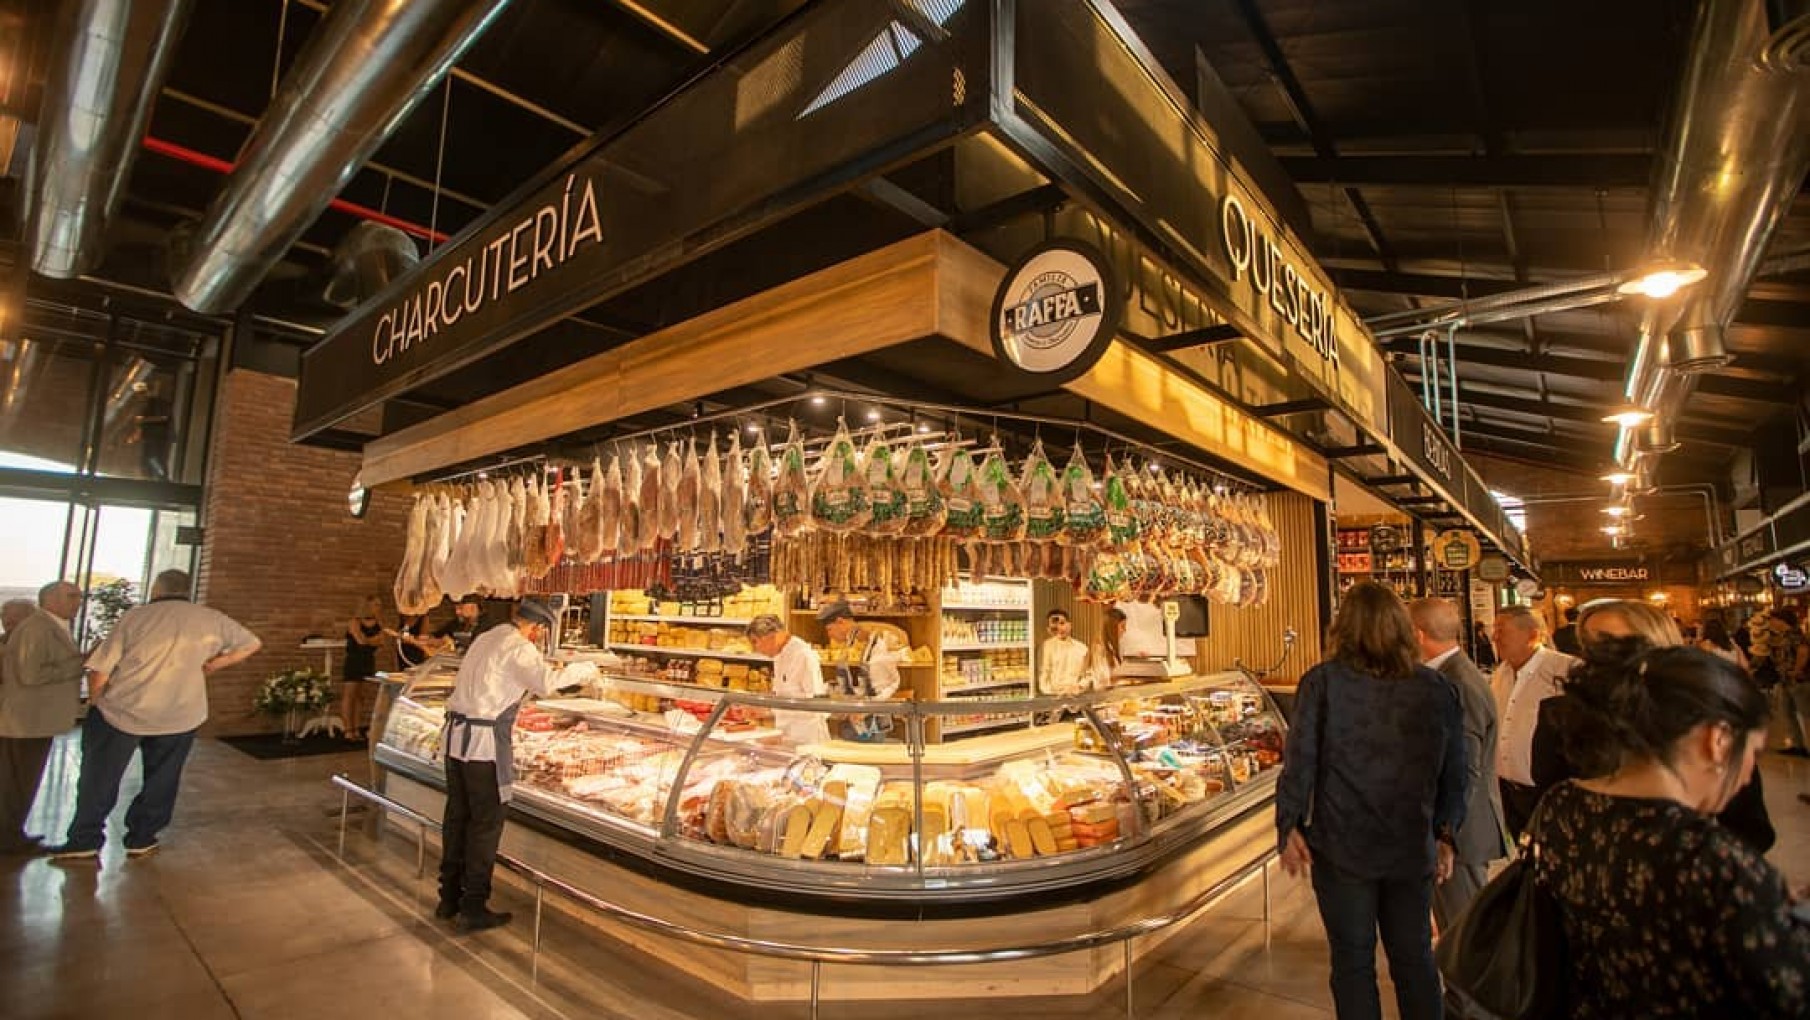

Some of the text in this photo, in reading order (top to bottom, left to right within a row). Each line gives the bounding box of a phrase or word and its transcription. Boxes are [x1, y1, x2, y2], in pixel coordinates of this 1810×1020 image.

[372, 174, 604, 365] CHARCUTERÍA
[1014, 291, 1082, 331] RAFFA
[1222, 194, 1340, 371] QUESERÍA
[1580, 567, 1649, 580] WINEBAR
